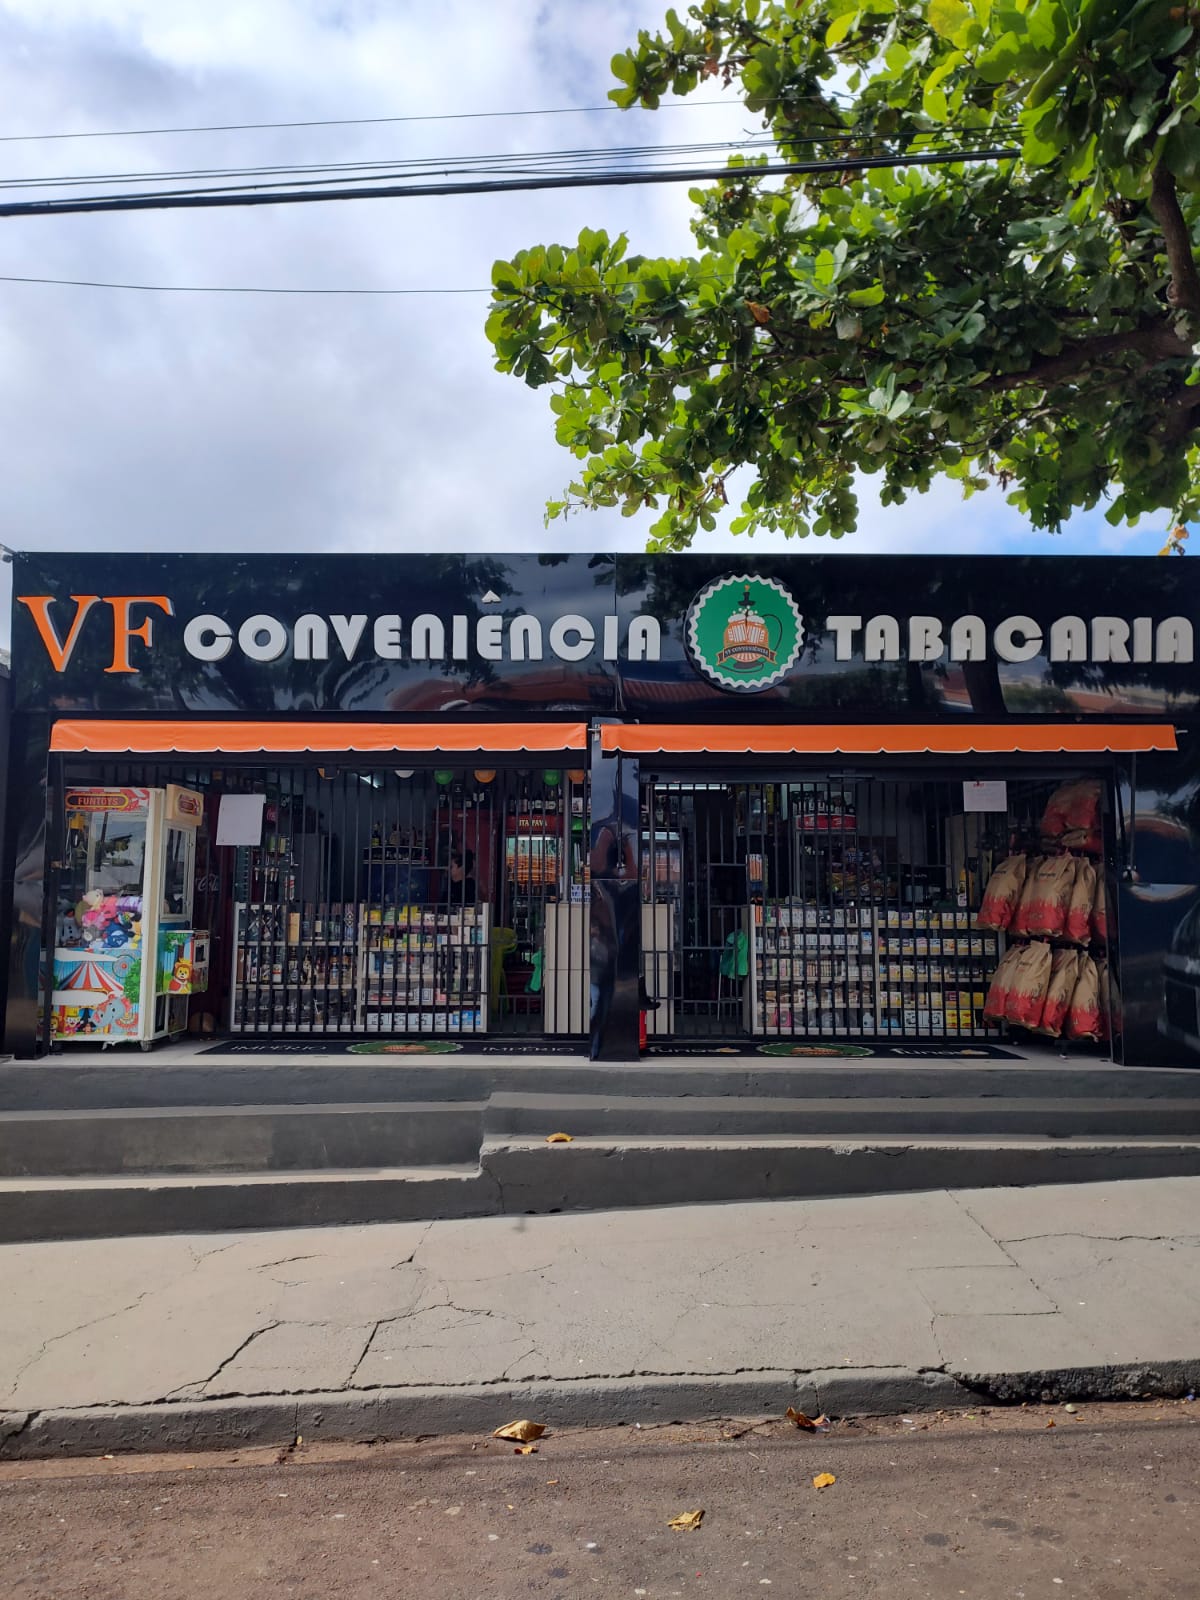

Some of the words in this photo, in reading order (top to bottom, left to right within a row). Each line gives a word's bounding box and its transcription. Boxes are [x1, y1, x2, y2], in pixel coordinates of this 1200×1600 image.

[17, 596, 175, 674] VF
[184, 590, 661, 662] CONVENIÊNCIA
[827, 615, 1195, 663] TABACARIA
[77, 796, 119, 806] FUNTOYS
[519, 819, 548, 827] ITAPAV
